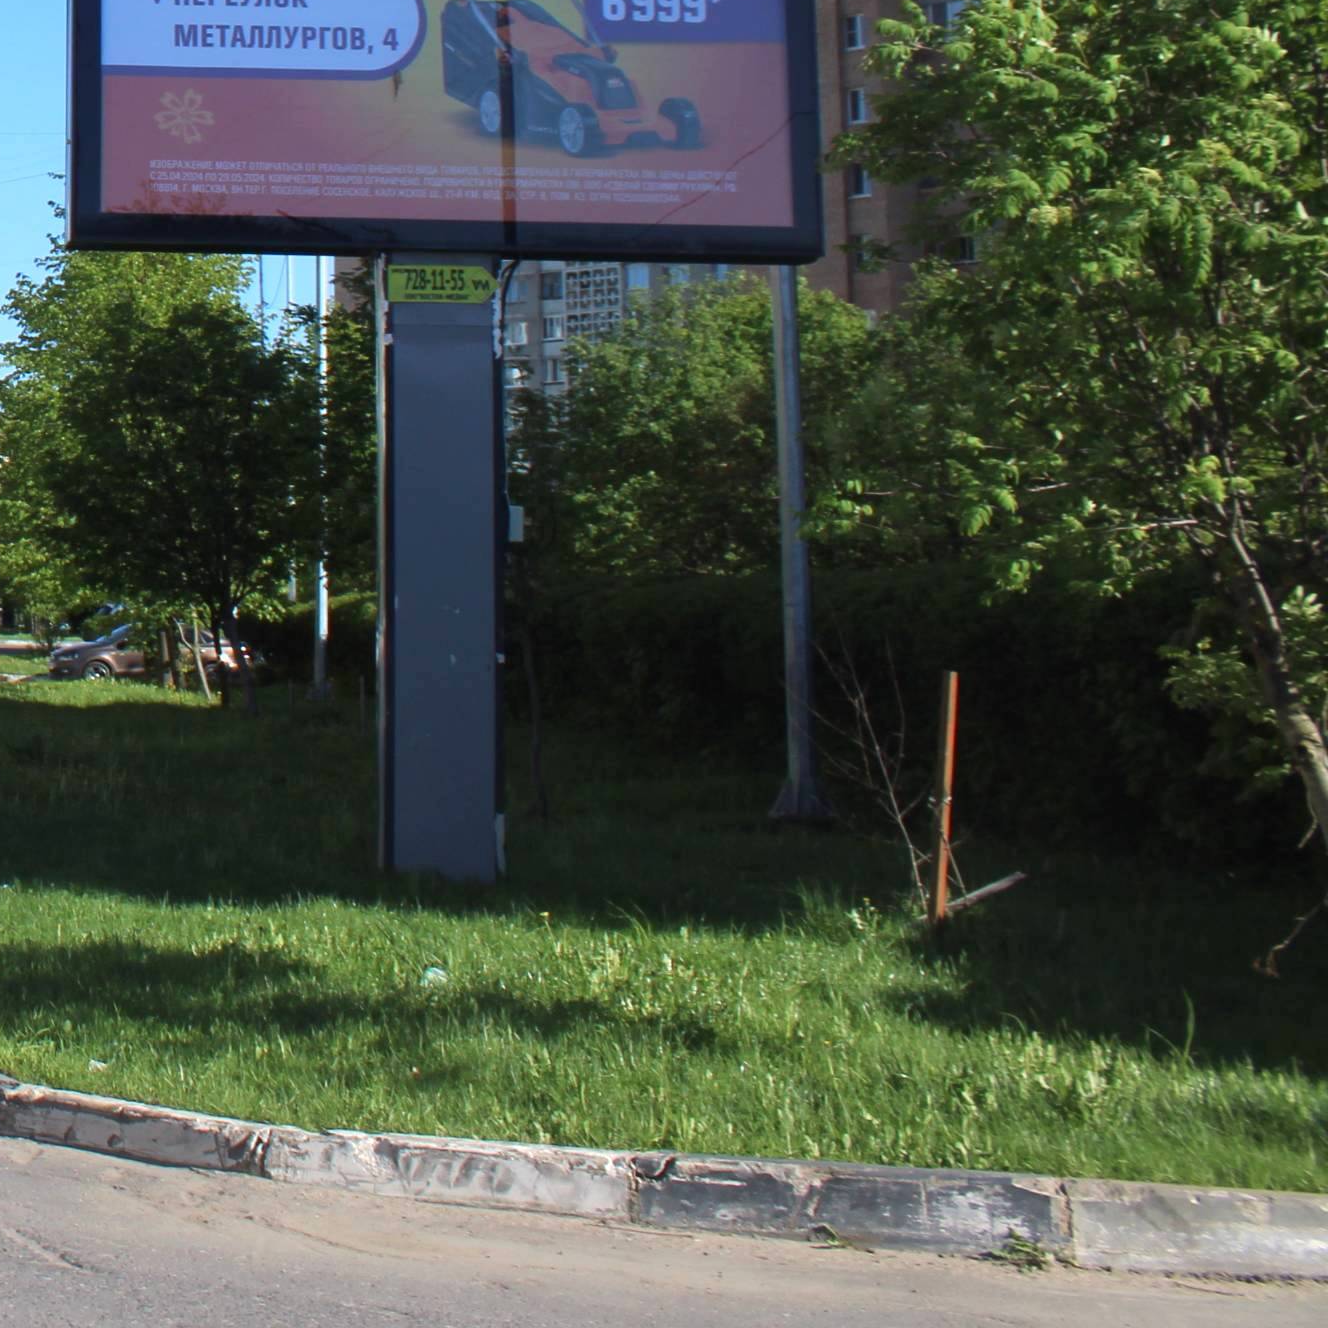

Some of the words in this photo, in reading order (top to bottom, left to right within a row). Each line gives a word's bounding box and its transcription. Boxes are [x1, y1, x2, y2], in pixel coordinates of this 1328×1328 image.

[173, 24, 374, 55] МЕТАЛЛУРГОВ,
[382, 27, 400, 51] 4
[405, 268, 465, 291] 728-11-55
